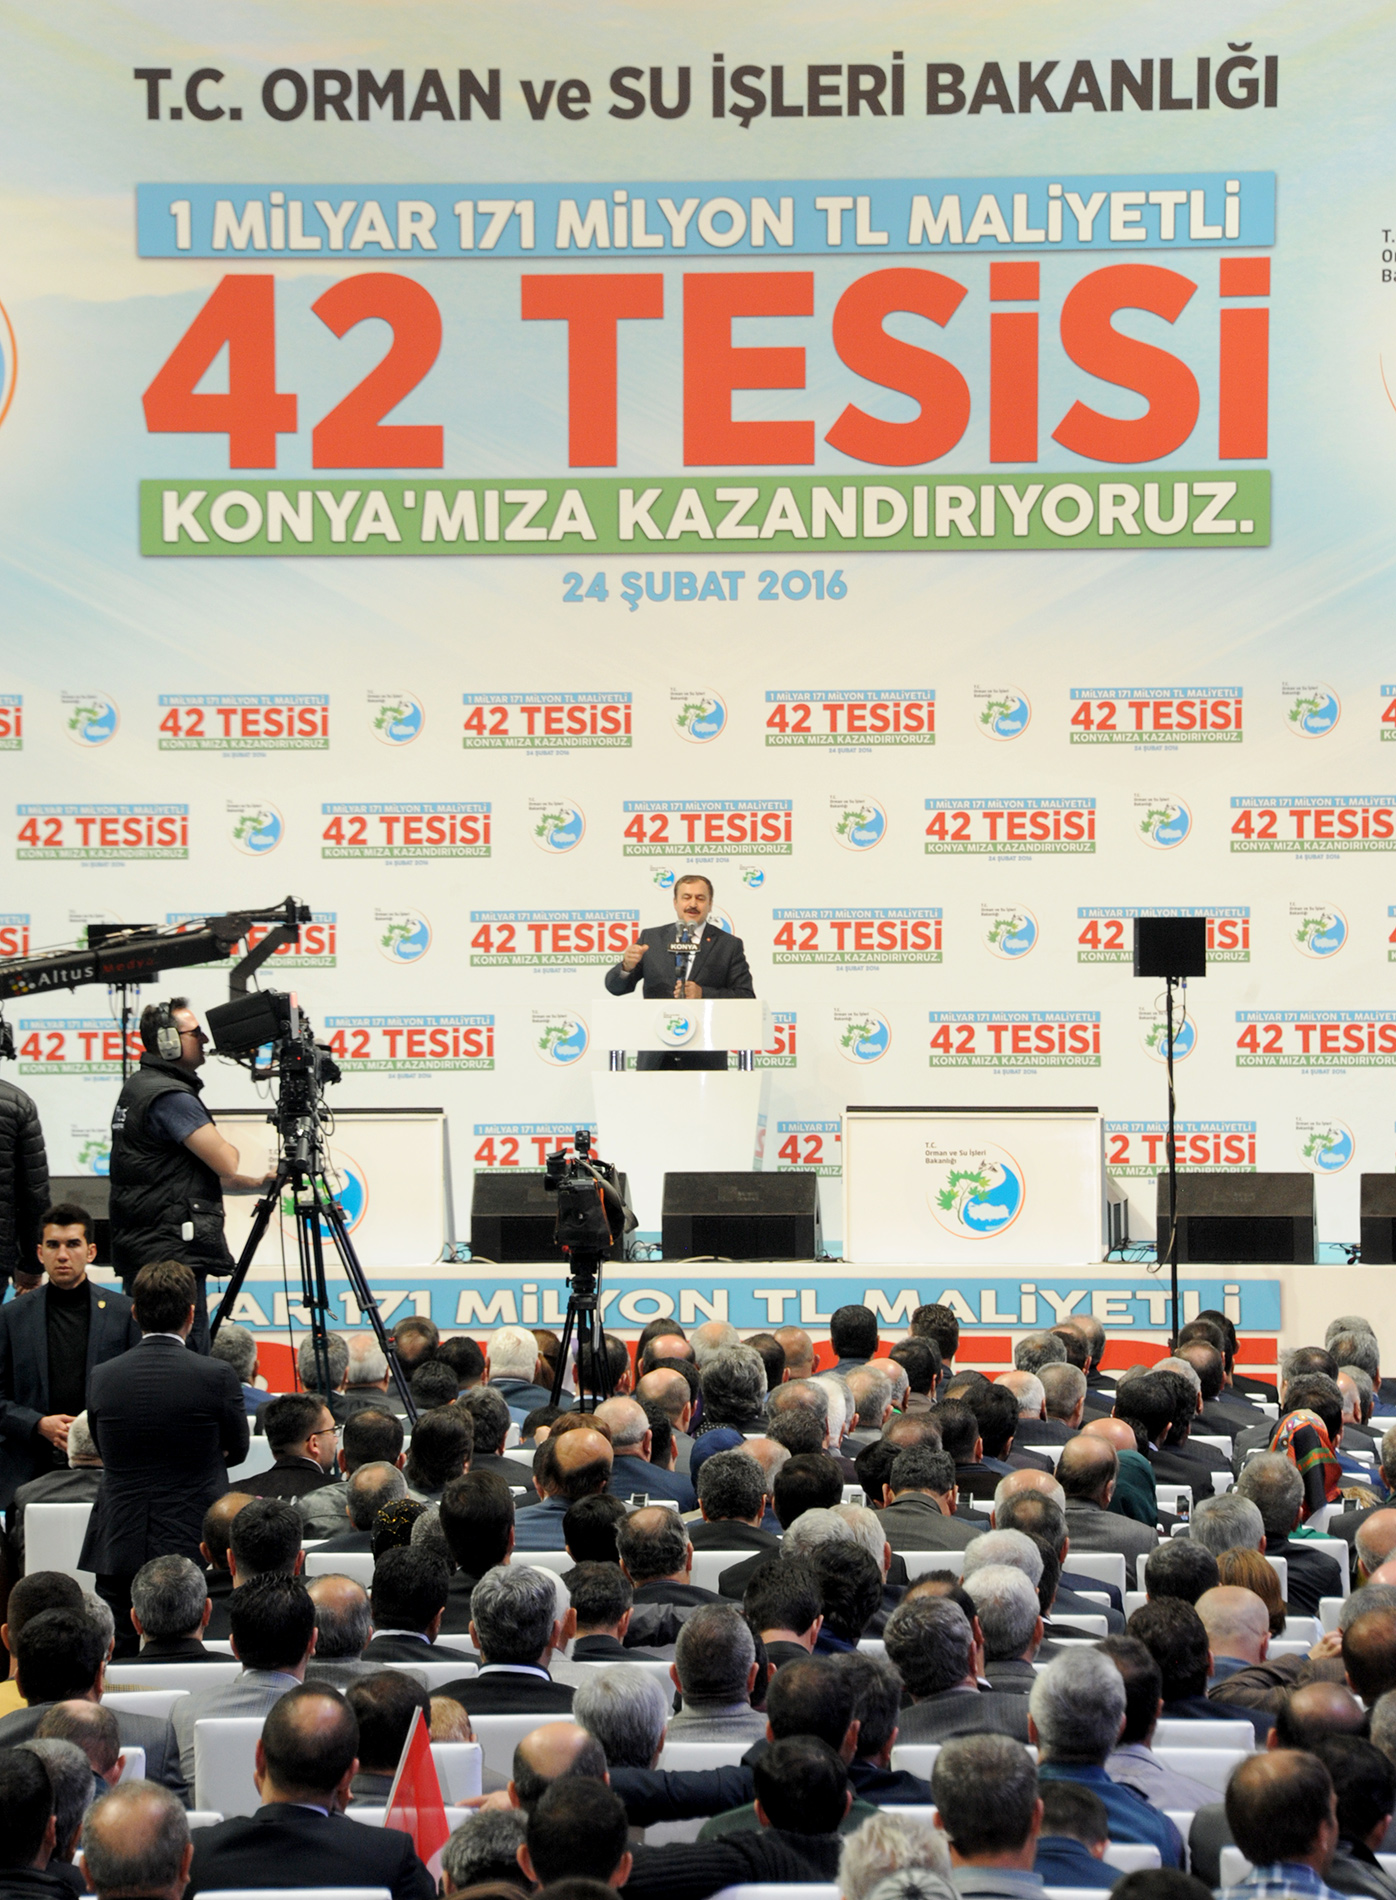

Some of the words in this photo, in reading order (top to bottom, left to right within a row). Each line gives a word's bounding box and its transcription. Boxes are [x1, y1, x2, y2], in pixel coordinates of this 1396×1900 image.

[134, 67, 243, 122] T.C.
[261, 68, 501, 122] ORMAN
[519, 77, 593, 121] ve
[608, 65, 692, 119] SU
[711, 50, 905, 130] İŞLERİ
[925, 41, 1280, 115] BAKANLIĞI
[169, 198, 192, 250] 1
[453, 199, 536, 250] 171
[815, 195, 889, 246] TL
[141, 272, 444, 469] 42
[162, 489, 597, 543] KONYA'MIZA
[618, 481, 1254, 541] KAZANDIRIYORUZ.
[563, 571, 608, 602] 24
[621, 570, 745, 611] ŞUBAT
[758, 568, 848, 601] 2016
[159, 707, 205, 737] 42
[463, 706, 509, 736] 42
[766, 703, 812, 733] 42
[1071, 700, 1117, 731] 42
[17, 817, 63, 847] 42
[322, 815, 368, 845] 42
[623, 813, 669, 843] 42
[925, 811, 971, 841] 42
[1231, 809, 1278, 839] 42
[470, 923, 516, 953] 42
[773, 922, 819, 951] 42
[1078, 920, 1124, 950] 42
[38, 966, 94, 987] Altus
[20, 1031, 66, 1061] 42
[930, 1024, 976, 1054] 42
[1236, 1024, 1283, 1054] 42
[474, 1137, 520, 1166] 42
[778, 1135, 824, 1164] 42
[753, 1289, 832, 1324] TL
